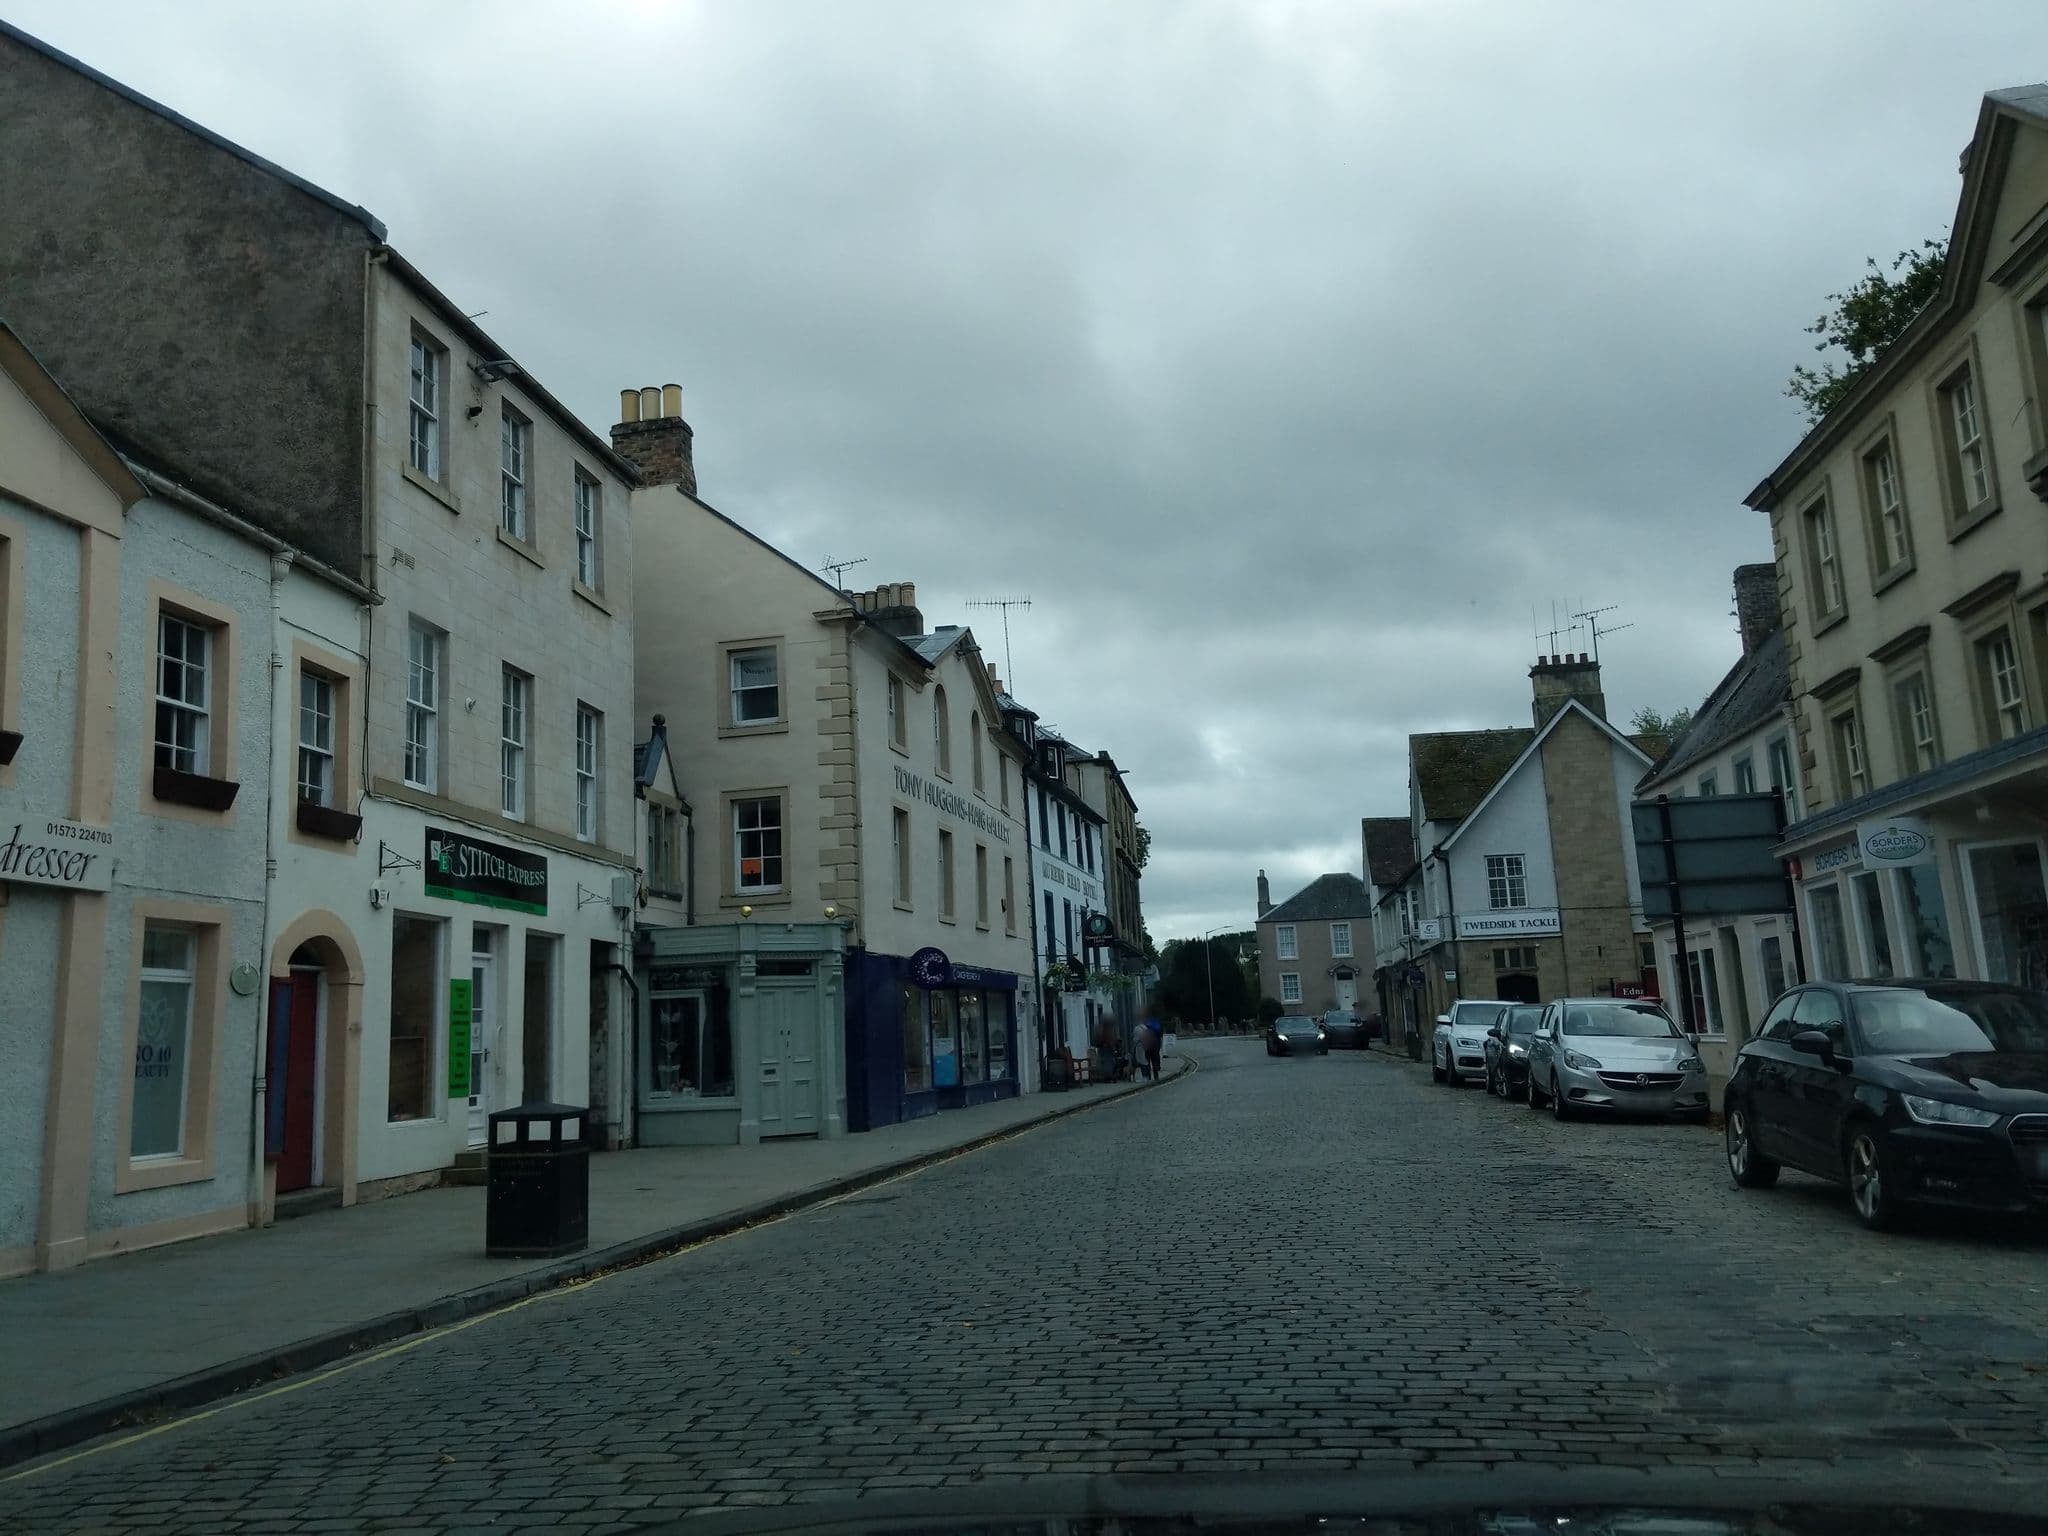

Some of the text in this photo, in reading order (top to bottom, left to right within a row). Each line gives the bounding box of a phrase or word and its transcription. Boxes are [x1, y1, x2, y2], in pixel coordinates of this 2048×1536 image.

[894, 765, 922, 800] TONY
[47, 822, 113, 845] 01573 224703
[1872, 835, 1919, 847] BORDERS
[0, 824, 97, 882] dresser
[459, 844, 545, 886] STITCH EXPRESS
[1815, 847, 1848, 871] BORDERS
[1463, 918, 1558, 931] TWEEDSIDE TACKLE
